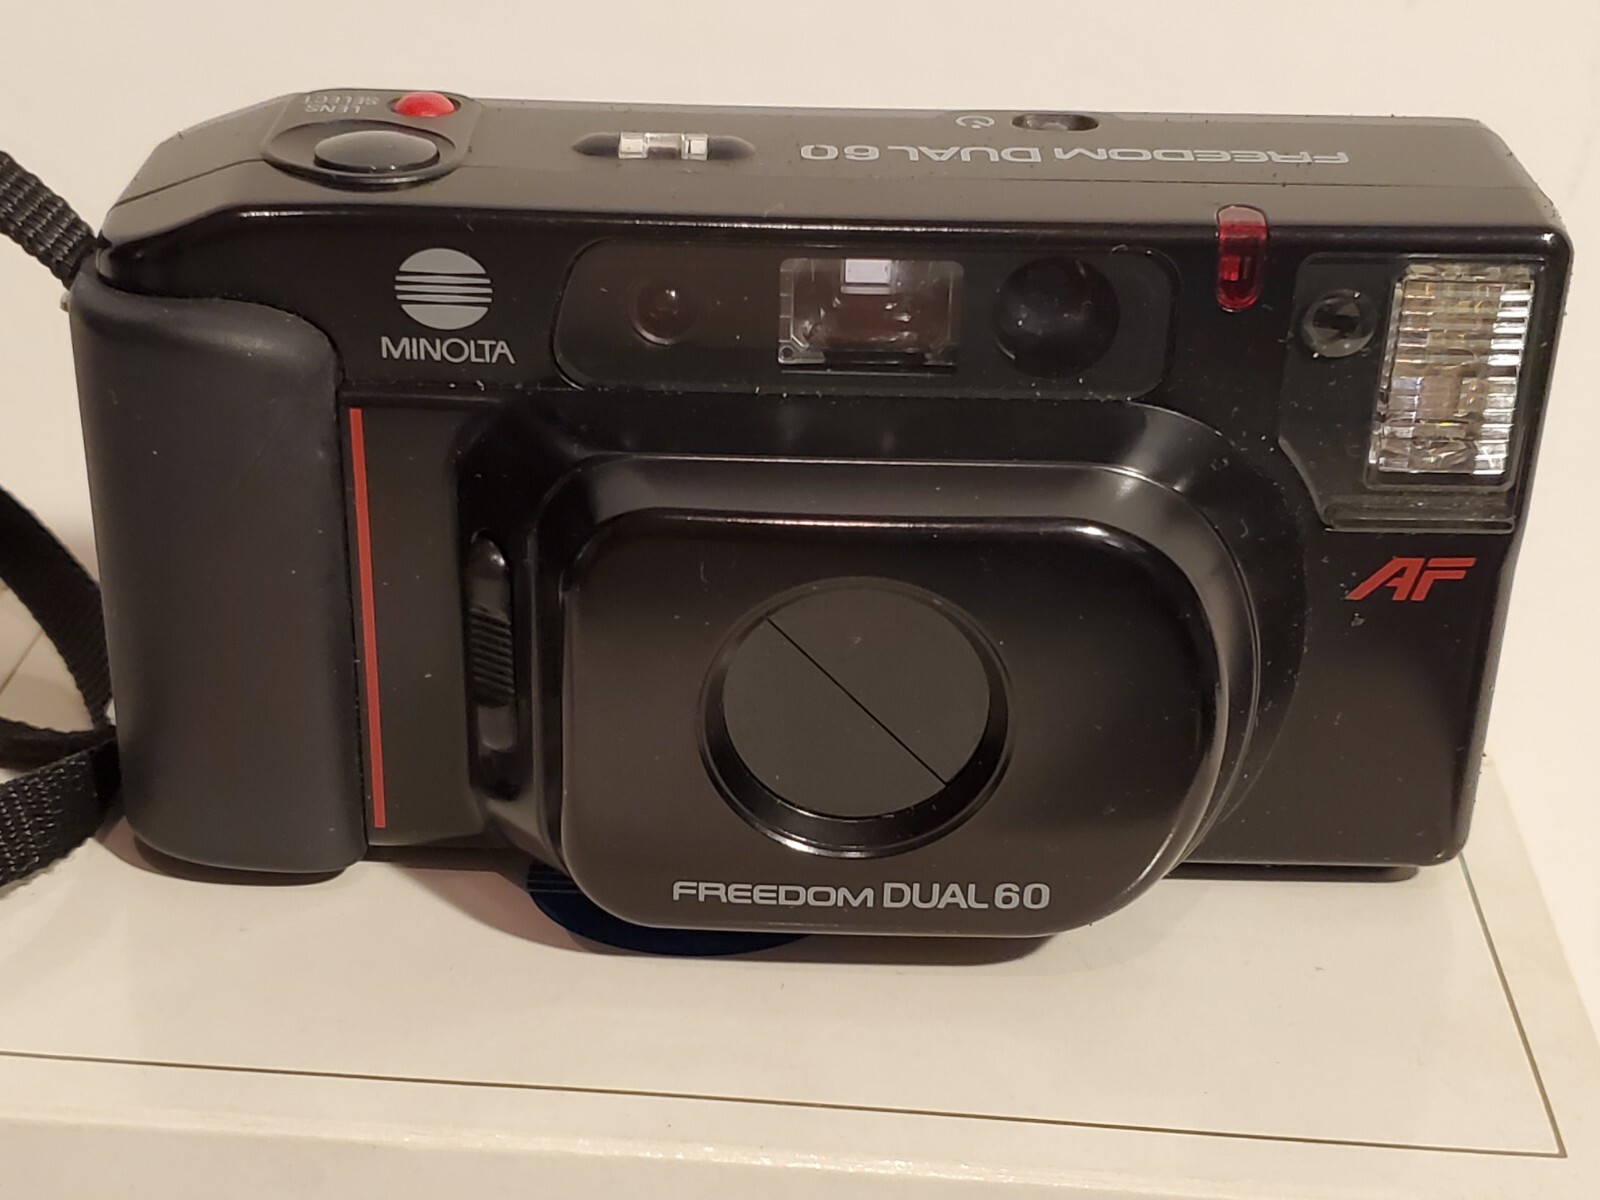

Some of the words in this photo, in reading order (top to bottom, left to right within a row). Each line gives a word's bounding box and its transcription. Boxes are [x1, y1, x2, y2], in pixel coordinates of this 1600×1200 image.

[800, 144, 880, 161] 60
[887, 145, 1042, 163] DUAL
[1053, 147, 1350, 164] FREEDOM
[381, 336, 516, 364] MINOLTA
[1344, 557, 1477, 601] AF
[672, 881, 874, 908] FREEDOM
[882, 882, 989, 909] DUAL
[993, 882, 1051, 910] 60
